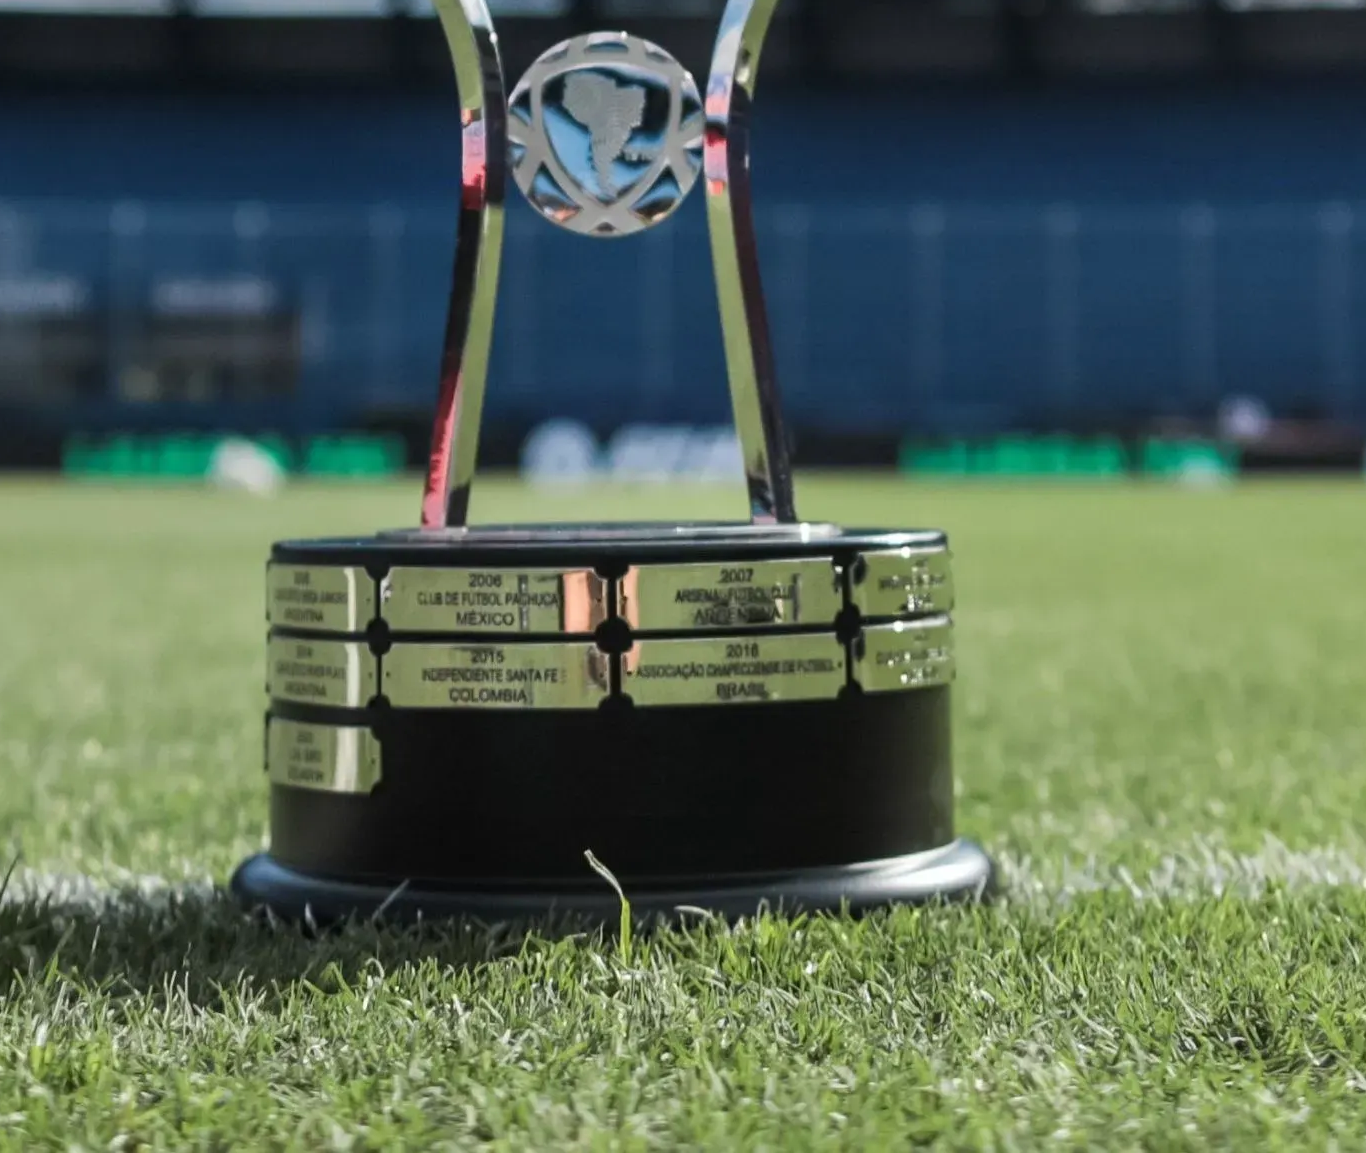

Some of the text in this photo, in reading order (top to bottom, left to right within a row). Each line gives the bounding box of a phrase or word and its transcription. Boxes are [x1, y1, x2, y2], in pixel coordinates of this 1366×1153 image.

[469, 573, 503, 588] 2006
[719, 568, 754, 583] 2007
[445, 592, 459, 606] DE
[505, 592, 559, 607] PACHUCA
[675, 588, 720, 603] ARSENA
[456, 609, 515, 627] MÉXICO
[693, 606, 782, 626] ARGENA
[471, 650, 504, 664] 2015
[421, 667, 558, 683] INDEPENDIENTE SANTA FE
[636, 661, 704, 680] ASSOCIAÇÃO
[449, 687, 528, 703] COLOMBIA
[716, 682, 766, 699] BRASIL
